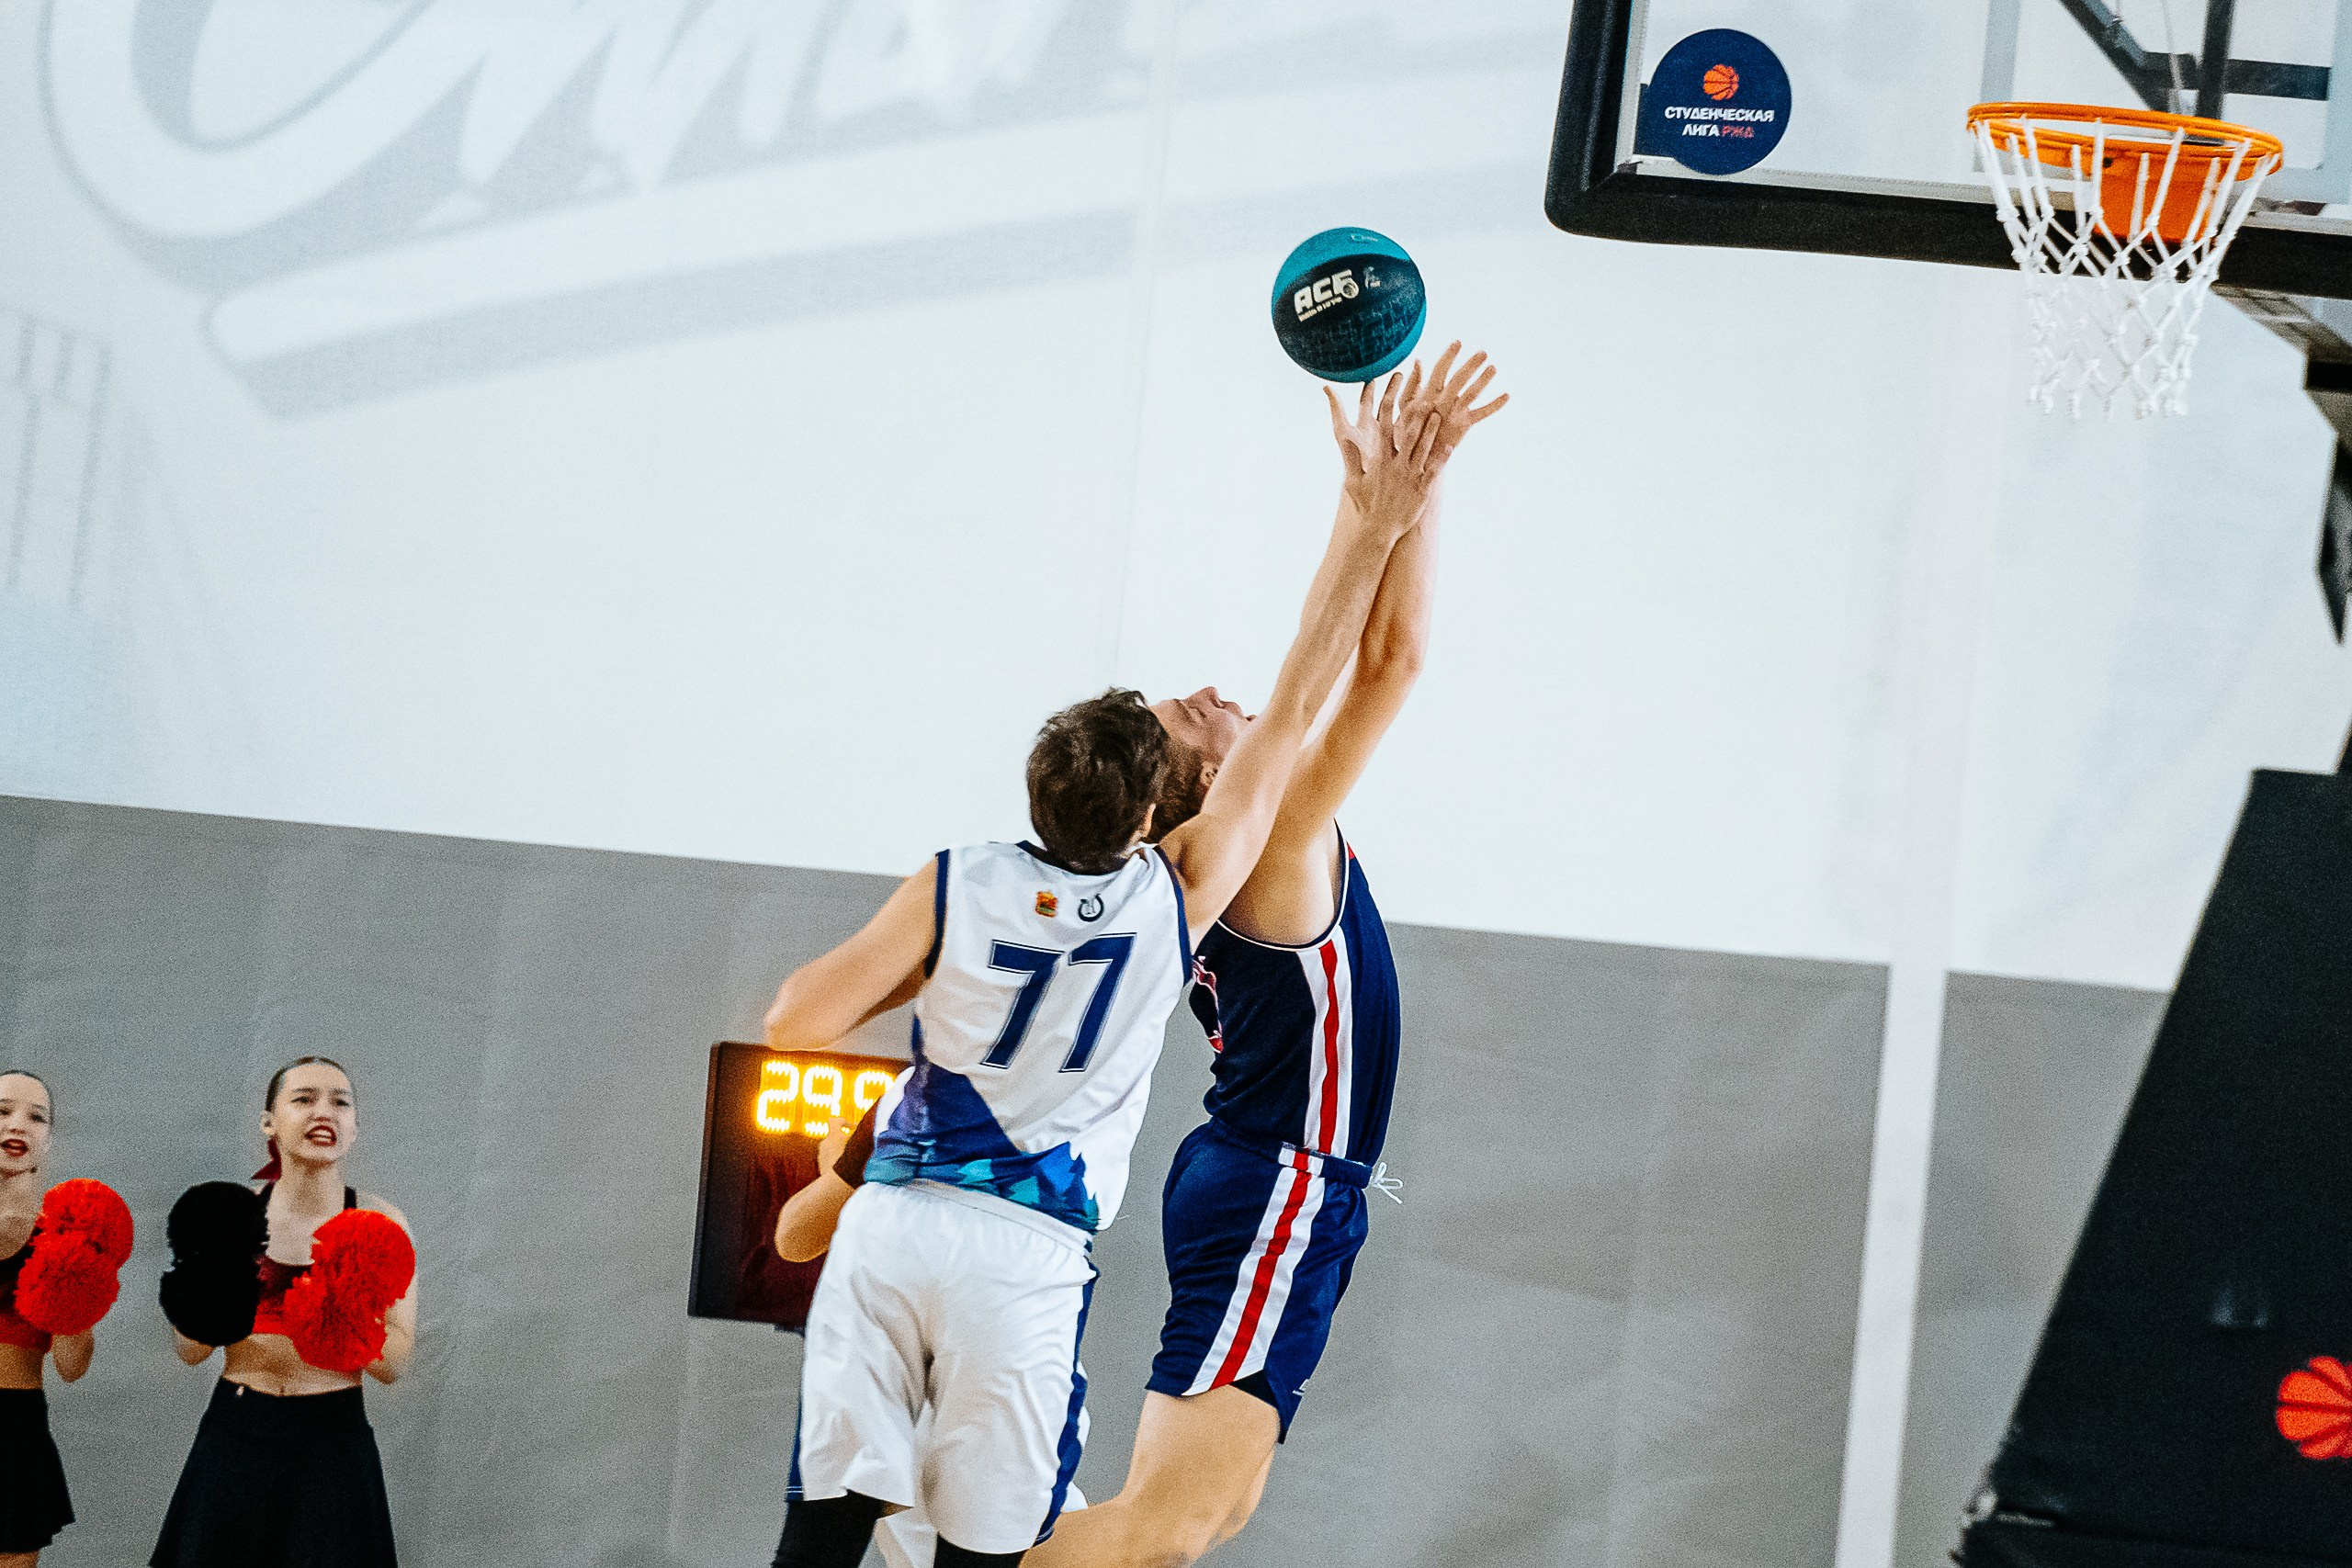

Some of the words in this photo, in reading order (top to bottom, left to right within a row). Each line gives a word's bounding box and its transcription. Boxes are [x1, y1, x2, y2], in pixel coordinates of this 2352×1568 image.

[1664, 106, 1775, 122] СТУДЕНЧЕСКАЯ
[1681, 123, 1721, 137] ЛИГА
[978, 931, 1138, 1074] 77
